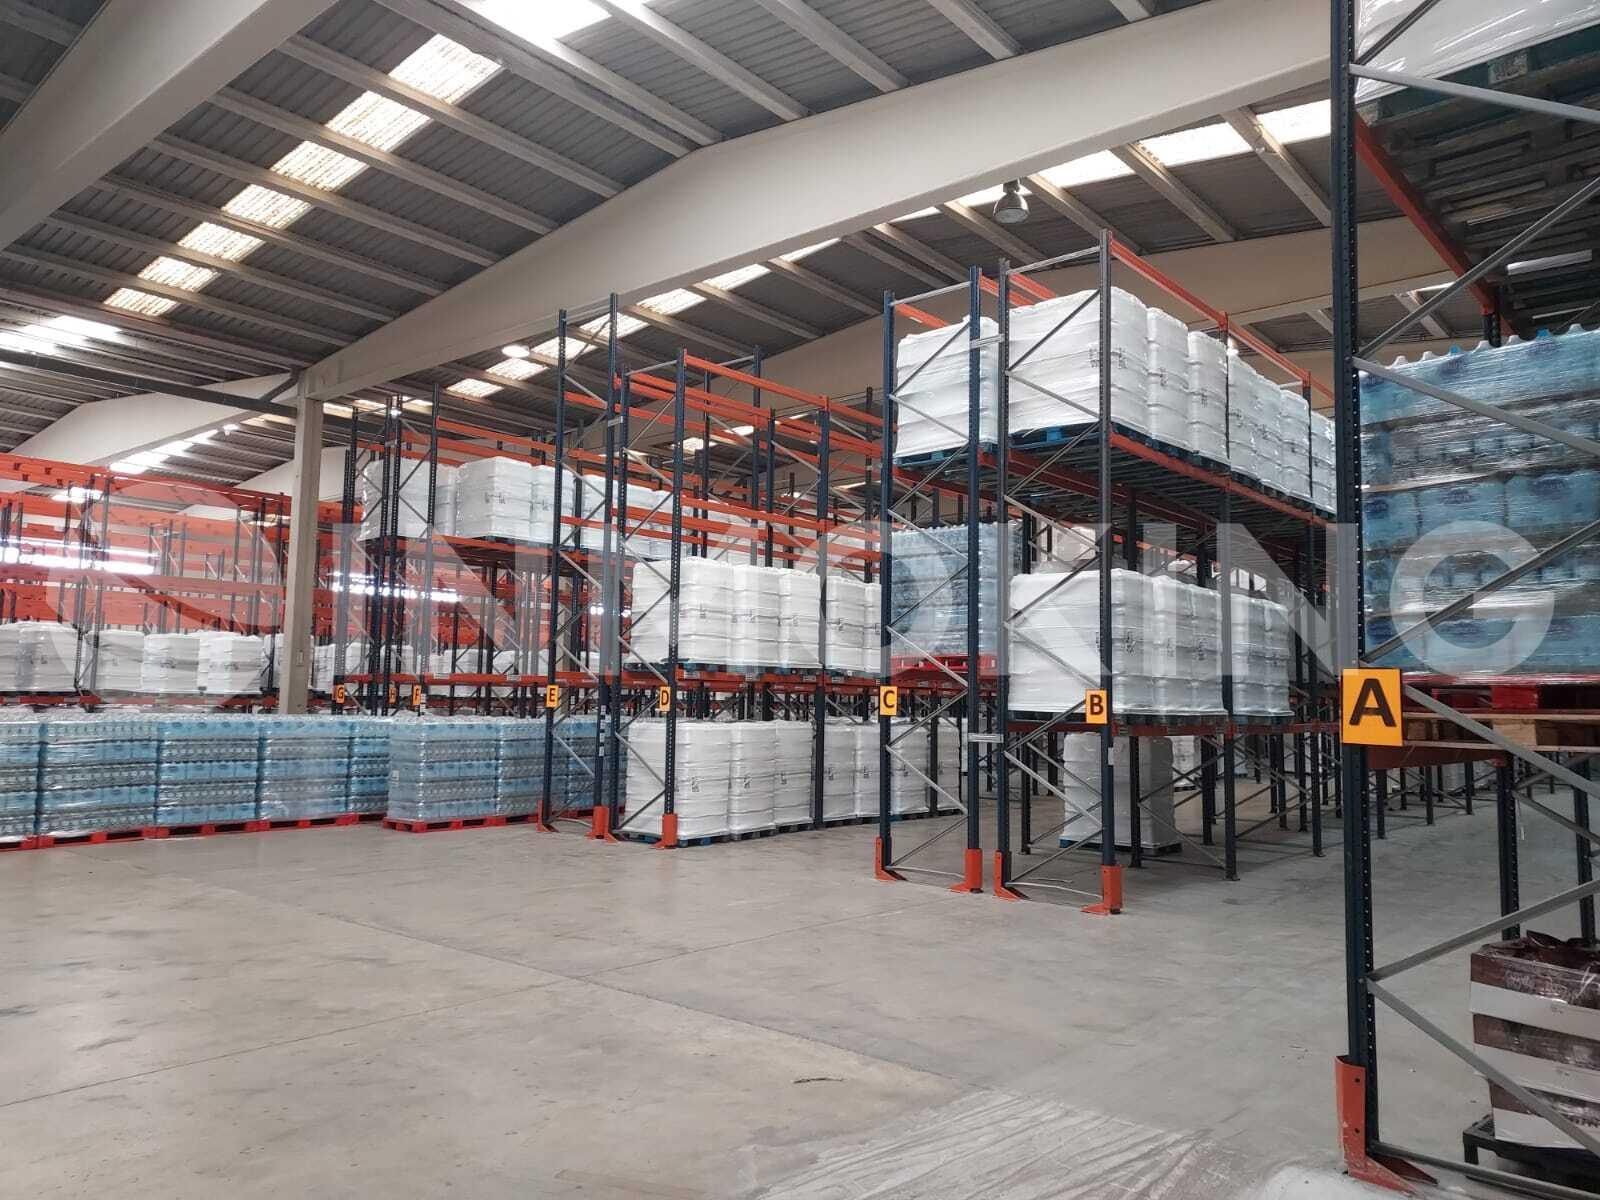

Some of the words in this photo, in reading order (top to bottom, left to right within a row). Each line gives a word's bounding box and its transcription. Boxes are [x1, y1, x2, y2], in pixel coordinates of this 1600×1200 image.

[549, 688, 556, 702] E
[661, 690, 670, 705] D
[882, 690, 895, 708] C
[1349, 678, 1397, 727] A
[1089, 694, 1104, 715] B
